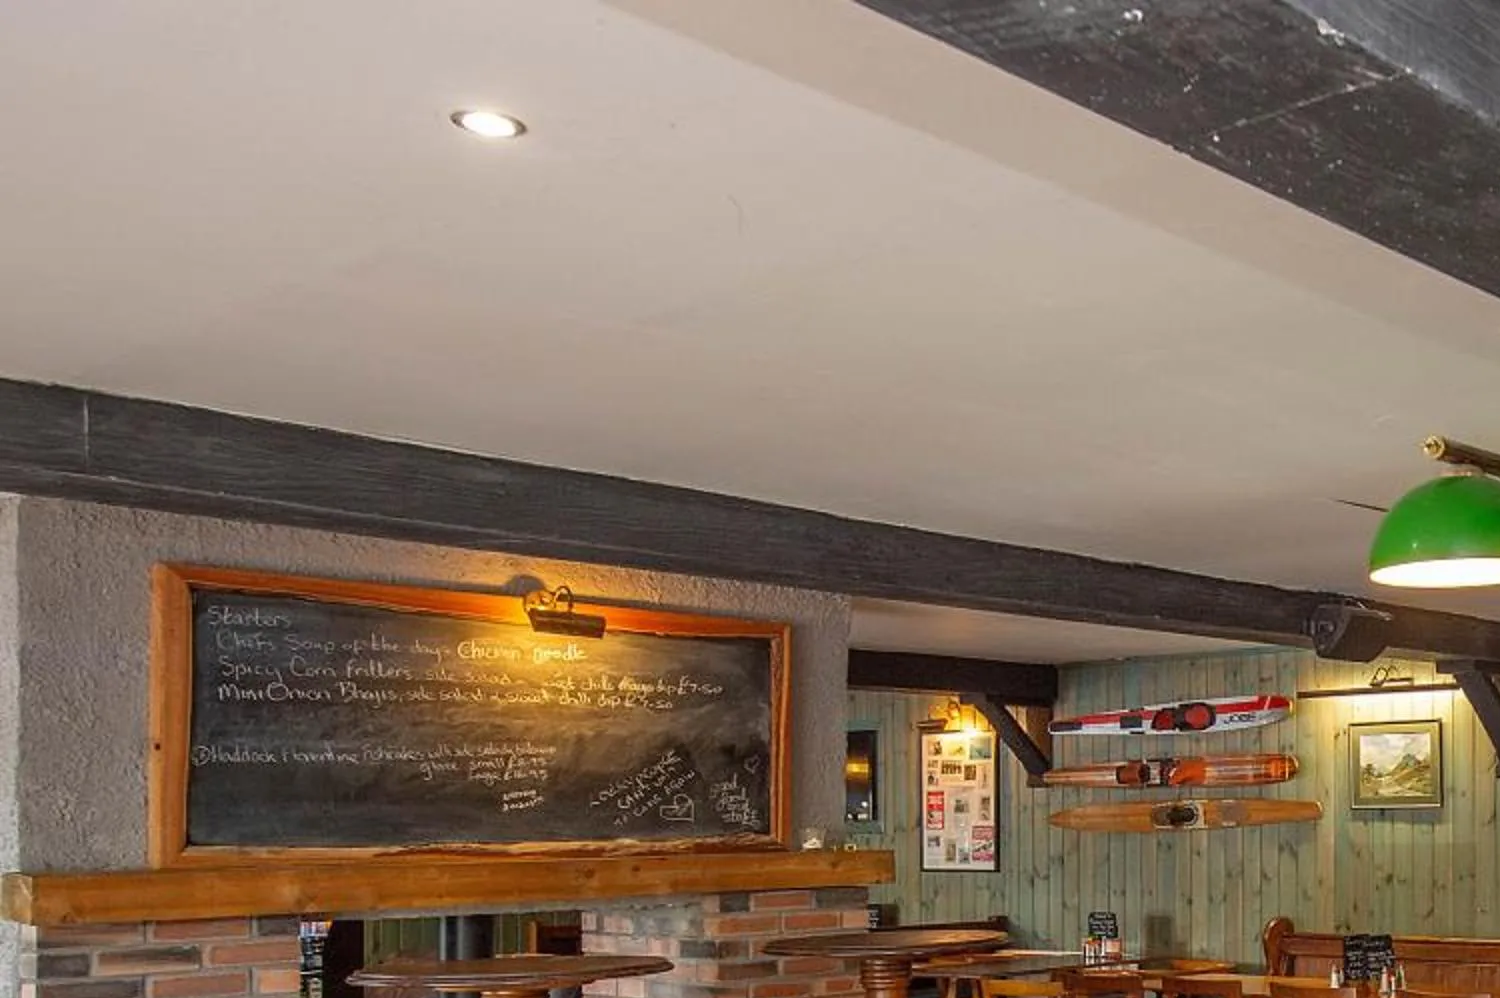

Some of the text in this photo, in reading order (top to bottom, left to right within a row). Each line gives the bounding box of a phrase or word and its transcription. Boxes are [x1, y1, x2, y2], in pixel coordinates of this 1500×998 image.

[207, 605, 292, 628] Starters
[285, 633, 335, 654] Soup
[371, 632, 400, 651] the
[218, 655, 283, 683] Spicy
[289, 655, 337, 677] Corn
[217, 683, 263, 701] Mini
[267, 682, 331, 701] Onion
